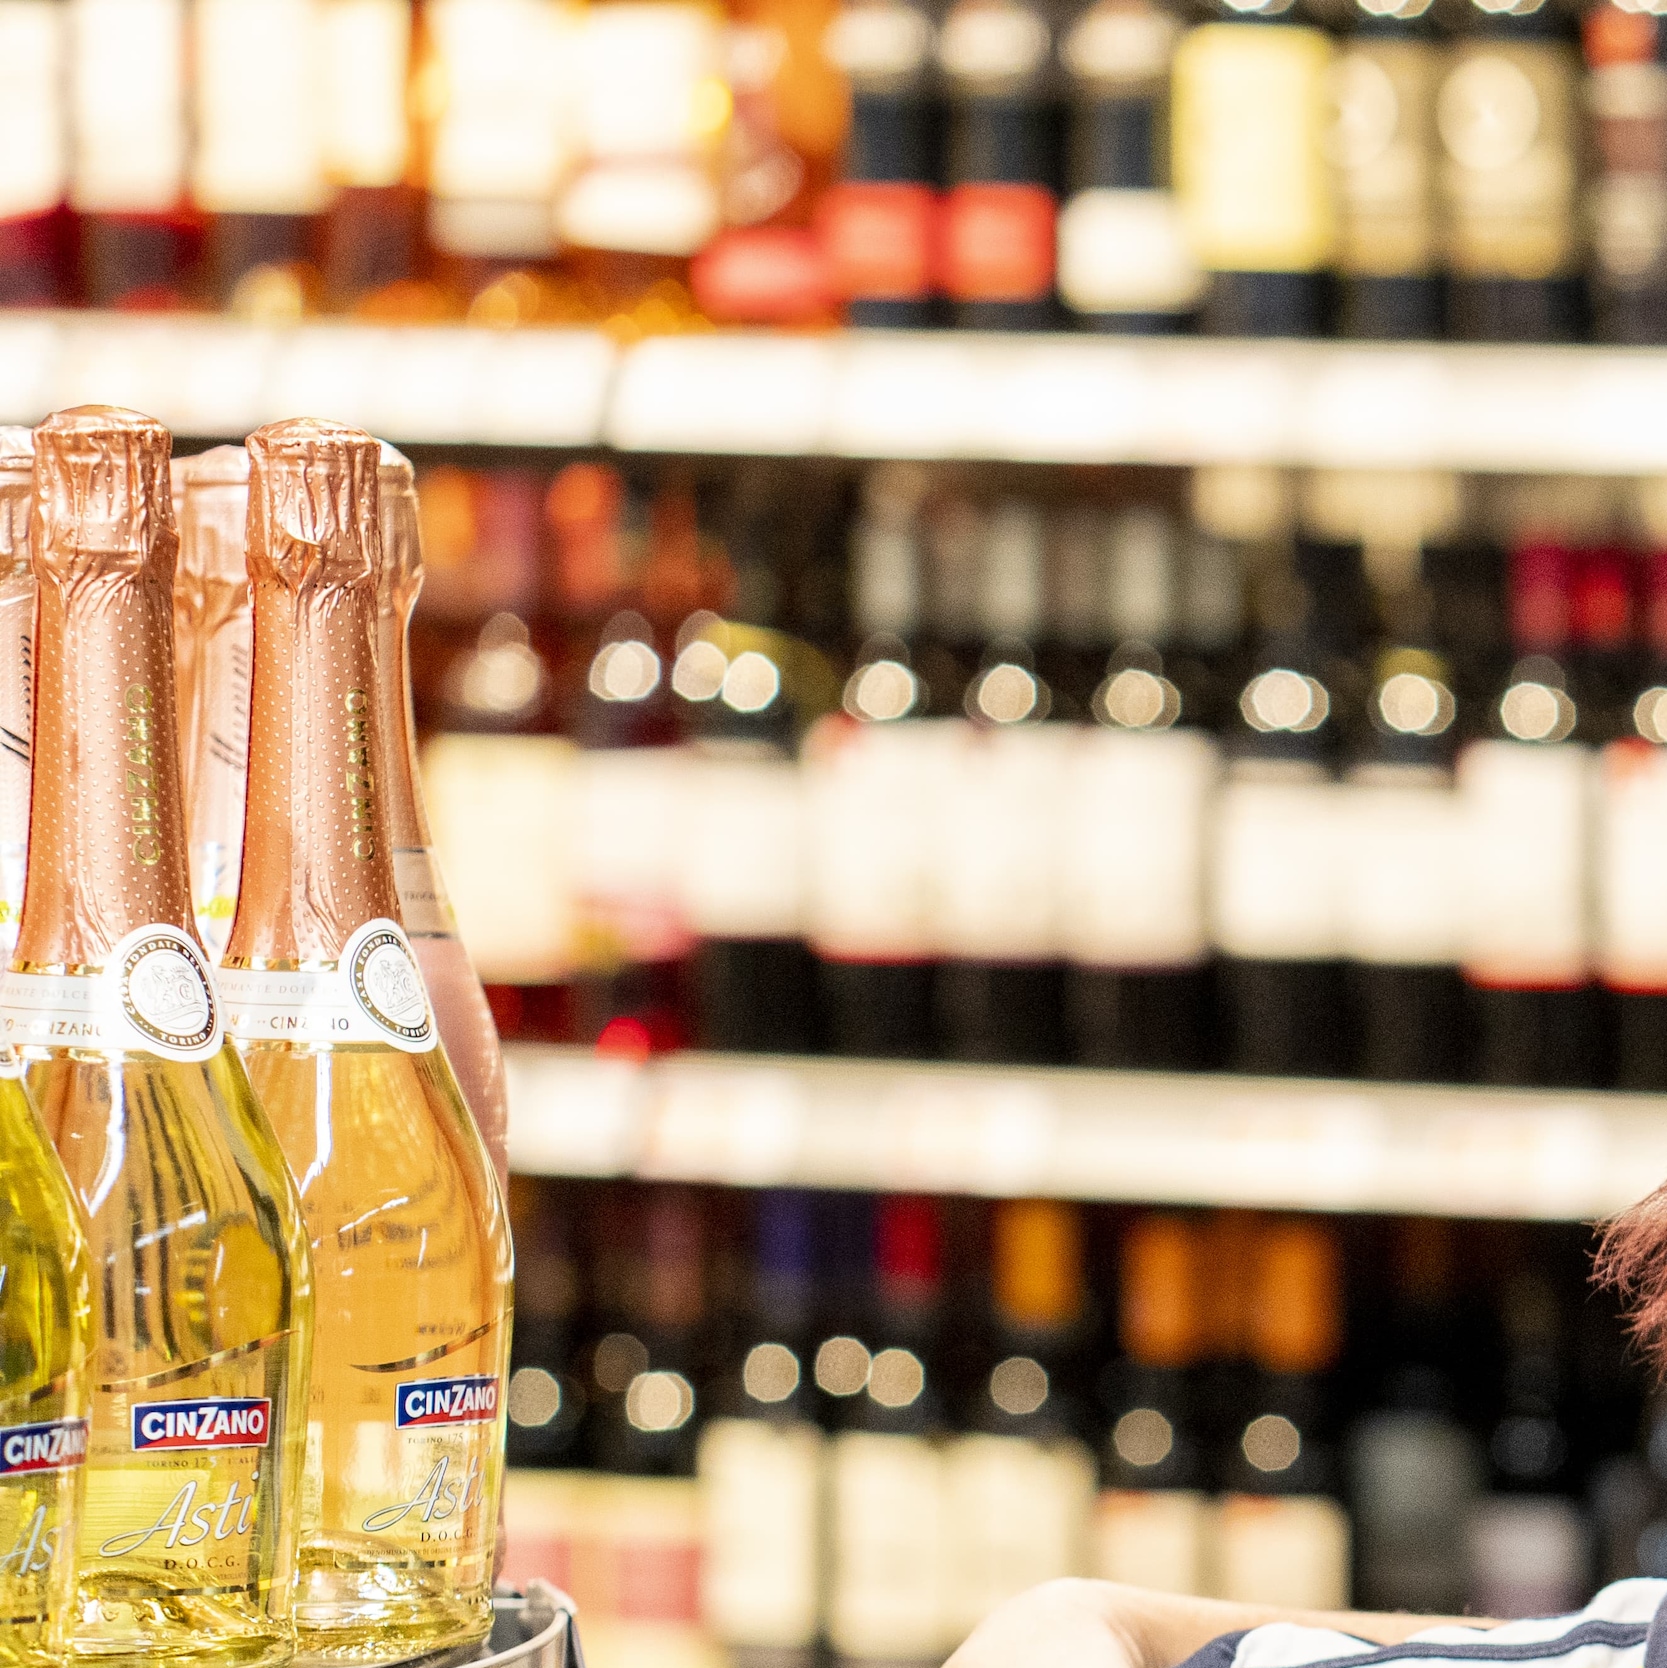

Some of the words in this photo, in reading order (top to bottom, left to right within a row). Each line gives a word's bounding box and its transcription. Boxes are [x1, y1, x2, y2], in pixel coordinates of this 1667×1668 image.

[125, 684, 163, 867] CINZANO
[344, 687, 377, 863] CINZANO
[124, 939, 179, 970] FONDATA
[160, 1032, 207, 1047] TORINO
[395, 1023, 429, 1037] TORINO
[405, 1384, 497, 1418] CINZANO
[141, 1406, 264, 1441] CINZANO
[362, 1447, 491, 1532] Asti
[100, 1471, 259, 1557] Asti
[164, 1555, 240, 1570] D.O.C.G.
